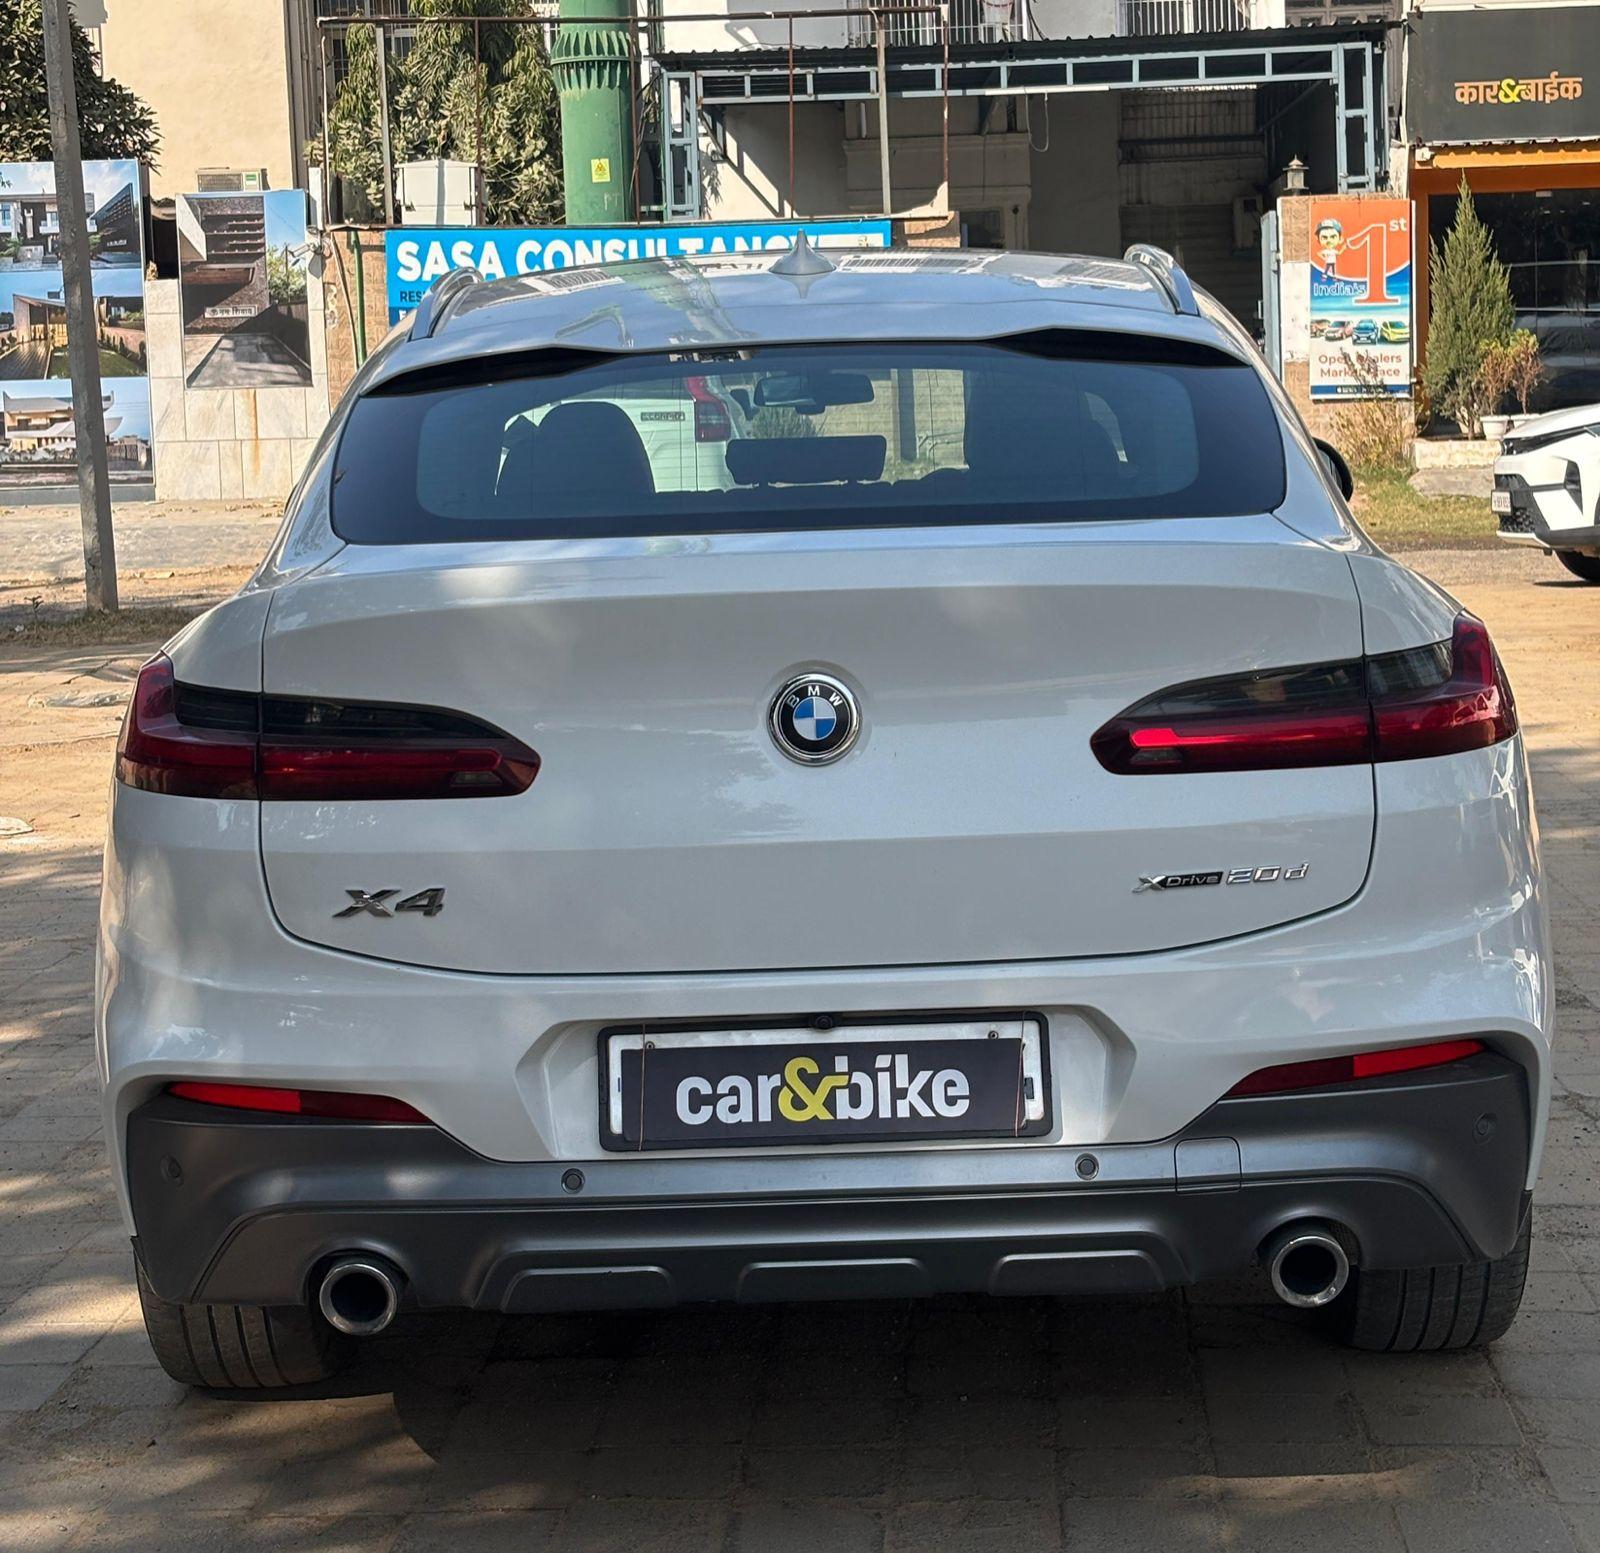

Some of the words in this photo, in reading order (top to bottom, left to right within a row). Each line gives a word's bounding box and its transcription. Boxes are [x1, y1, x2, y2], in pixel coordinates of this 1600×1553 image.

[1454, 71, 1582, 104] कार&बाईक
[397, 240, 506, 282] SASA
[400, 290, 426, 302] RES
[1313, 282, 1366, 296] India's
[1318, 354, 1352, 366] Ope
[786, 685, 843, 708] BMW
[332, 887, 446, 918] X4
[676, 1054, 970, 1126] car&bike
